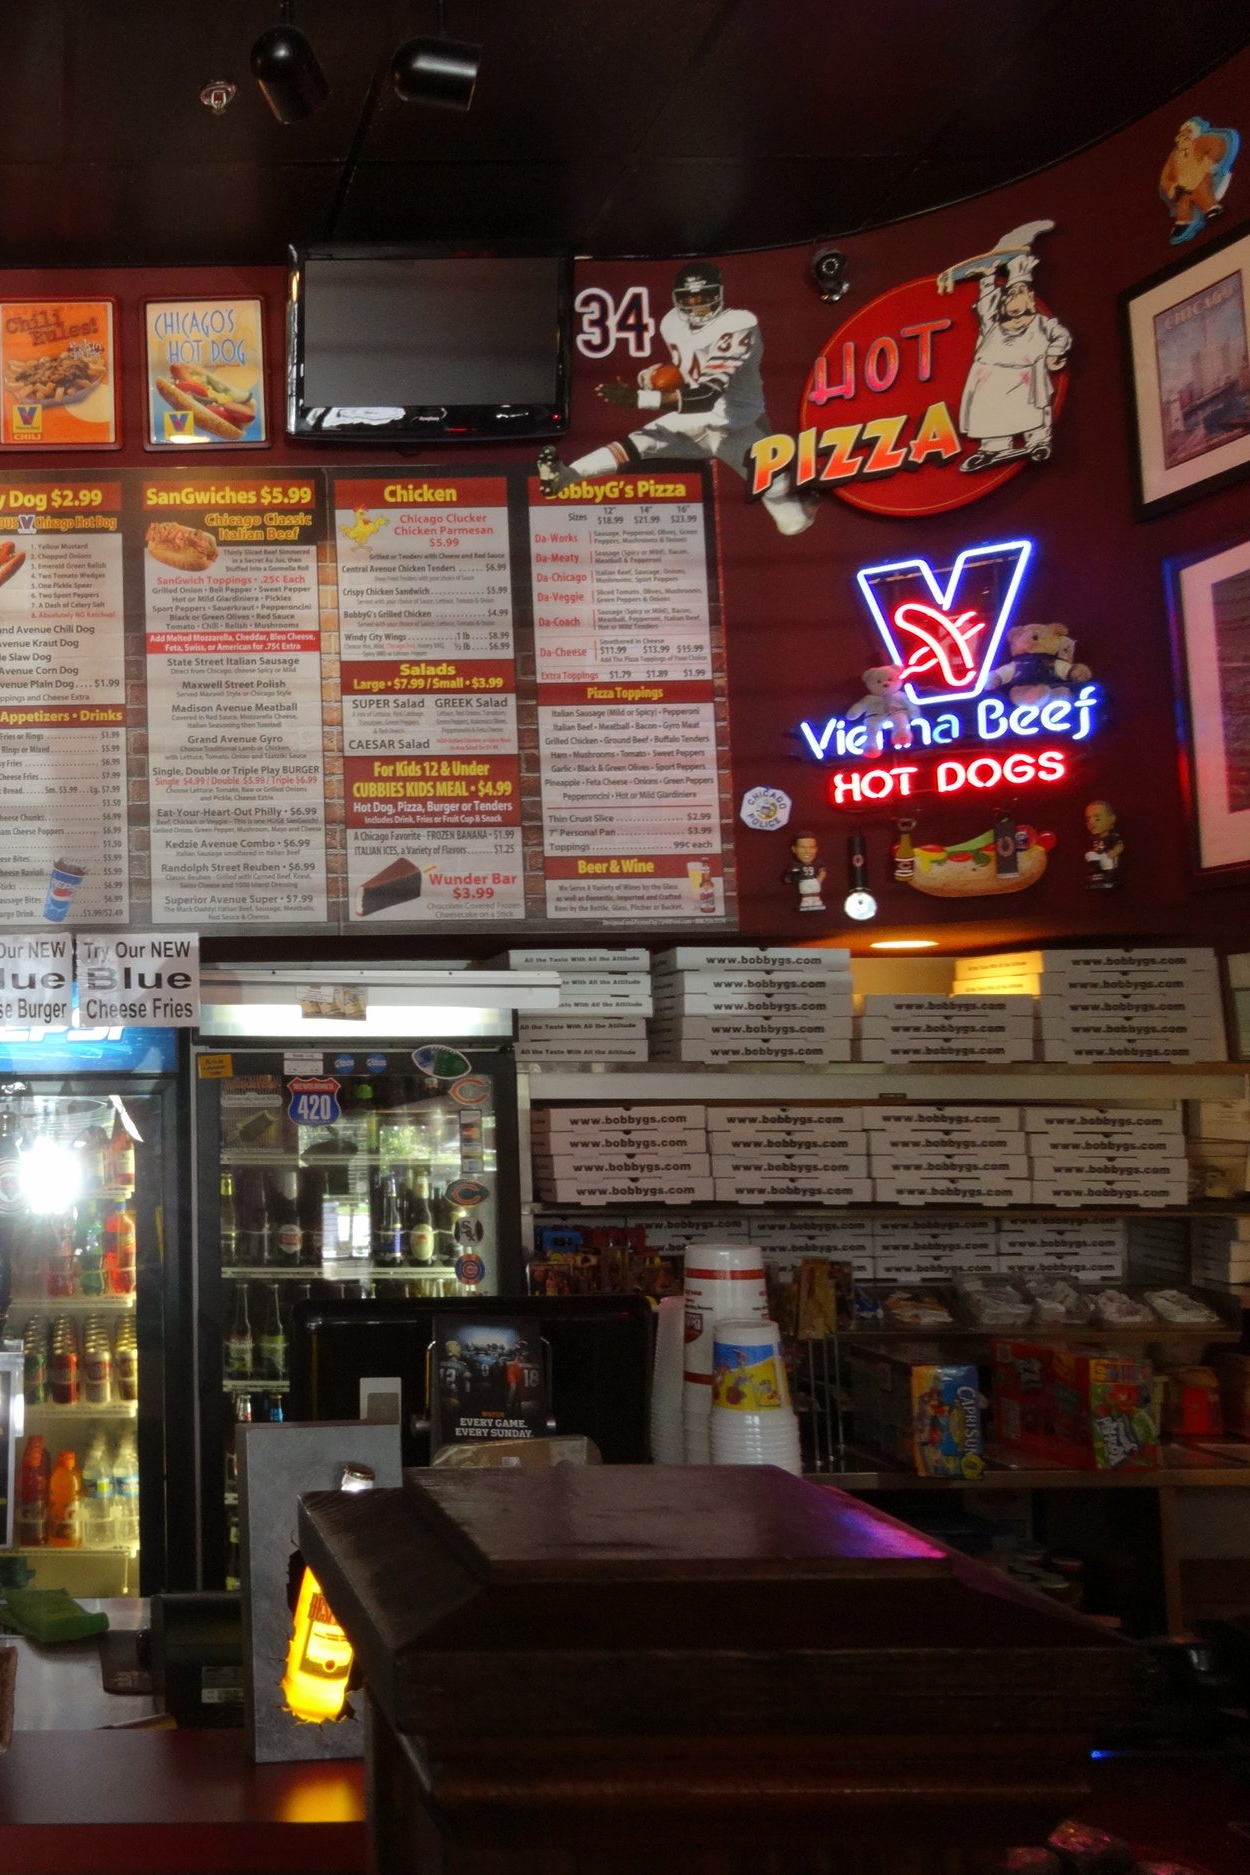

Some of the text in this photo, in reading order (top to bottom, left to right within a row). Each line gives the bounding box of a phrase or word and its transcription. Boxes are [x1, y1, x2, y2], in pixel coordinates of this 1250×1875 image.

[6, 309, 61, 335] Chili
[155, 309, 234, 340] CHICAGO'S
[574, 287, 654, 358] 34
[30, 317, 98, 346] Rules!
[169, 339, 245, 365] HOT DOG
[808, 319, 951, 405] HOT
[749, 401, 961, 495] PIZZA
[384, 485, 457, 503] Chicken
[638, 480, 685, 497] Pizza
[10, 491, 46, 511] Dog
[51, 489, 102, 508] $2.99
[147, 487, 311, 506] SanGwiches $5.99
[205, 512, 312, 527] Chicago Classic
[400, 512, 487, 525] Chicago Clucker
[219, 527, 298, 540] Italian Beef
[394, 525, 493, 536] Chicken Parmesan
[429, 537, 459, 548] $5.99
[535, 533, 578, 544] Da-Works
[536, 553, 579, 565] Da-Meaty
[537, 572, 587, 584] Da-Chicago
[538, 591, 584, 604] Da-Veggie
[17, 625, 51, 635] Avenue
[54, 624, 72, 634] Chili
[75, 624, 95, 637] Dog
[540, 646, 587, 658] Da-Cheese
[400, 663, 455, 676] Salads
[182, 679, 286, 689] Maxwell Street Polish
[354, 676, 503, 692] Large $7.99 Small $3.99
[587, 686, 663, 701] Pizza Toppings
[1, 710, 69, 724] Appetizers
[80, 709, 122, 722] Drinks
[977, 685, 1097, 740] Beef
[374, 762, 489, 777] For Kids 12 & Under
[833, 750, 1065, 805] HOT DOGS
[353, 781, 511, 798] CUBBIES KIDS MEAL $4.99
[746, 790, 788, 810] CHICAGO
[747, 813, 782, 828] POLICE
[166, 838, 310, 849] Kedzie Avenue Combo $6.99
[578, 859, 654, 874] Beer & Wine
[429, 873, 517, 885] Wunder Bar
[453, 887, 494, 900] $3.99
[29, 942, 66, 958] NEW
[84, 941, 190, 963] Try Our NEW
[706, 955, 821, 966] www.bobbygs.com
[1072, 956, 1187, 967] www.bobbygs.com
[88, 967, 192, 990] Blue
[18, 999, 67, 1023] Burger
[87, 998, 193, 1019] Cheese Fries
[712, 1024, 825, 1035] www.bobbygs.com
[711, 1046, 823, 1057] www.bobbygs.com
[298, 1095, 331, 1120] 420
[570, 1113, 687, 1127] www.bobbygs.com
[727, 1114, 844, 1126] www.bobbygs.com
[570, 1137, 687, 1150] www.bobbygs.com
[732, 1138, 848, 1149] www.bobbygs.com
[890, 1139, 1007, 1150] www.bobbygs.com
[1050, 1141, 1166, 1152] www.bobbygs.com
[577, 1186, 695, 1198] www.bobbygs.com
[735, 1186, 853, 1197] www.bobbygs.com
[523, 1369, 539, 1387] 18
[460, 1418, 527, 1429] EVERY GAME.
[455, 1428, 534, 1438] EVERY SUNDAY.
